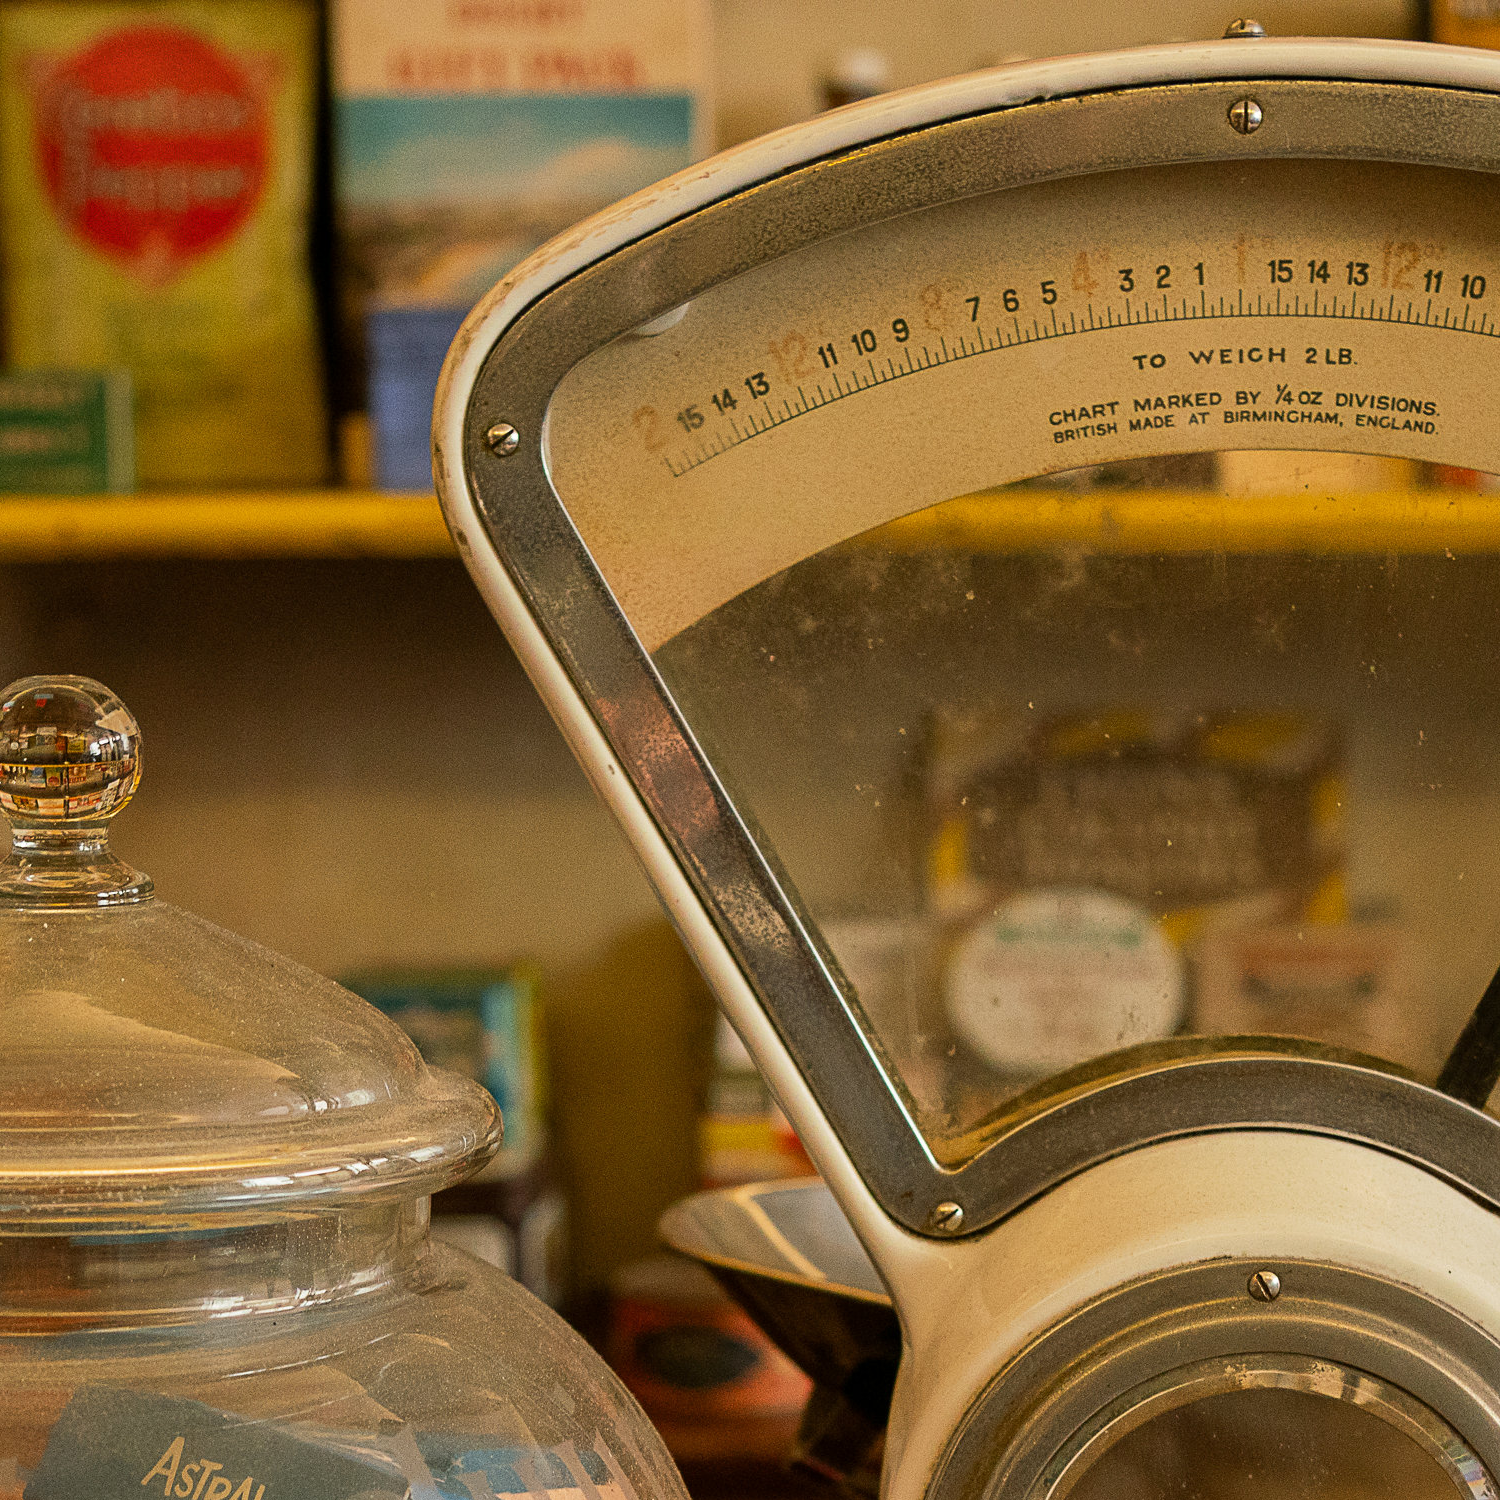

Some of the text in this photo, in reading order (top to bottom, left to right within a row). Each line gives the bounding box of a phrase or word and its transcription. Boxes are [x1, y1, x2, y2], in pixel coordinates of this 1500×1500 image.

[676, 403, 705, 434] 15
[711, 387, 738, 416] 14
[744, 371, 771, 402] 13
[769, 329, 819, 383] 12
[817, 343, 840, 370] 11
[851, 328, 878, 355] 10
[891, 318, 911, 344] 9
[965, 296, 982, 323] 7
[1003, 288, 1021, 313] 6
[1040, 280, 1058, 306] 5
[1071, 250, 1098, 297] 4
[1119, 268, 1135, 293] 3
[1156, 265, 1172, 289] 2
[1194, 262, 1205, 286] 1
[1268, 259, 1293, 284] 15
[1307, 259, 1332, 284] 14
[1346, 261, 1370, 286] 13
[1380, 239, 1421, 290] 12
[1423, 269, 1445, 294] 11
[1460, 274, 1487, 300] 10
[1132, 352, 1167, 371] TO
[1188, 346, 1287, 367] WEIGH
[1048, 400, 1120, 427] CHART
[1133, 390, 1223, 413] MARKED
[1235, 389, 1261, 406] BY
[1334, 391, 1442, 418] DIVISIONS.
[1052, 409, 1440, 446] BRITISH MADE AT BIRMINGHAM, ENGLAND.
